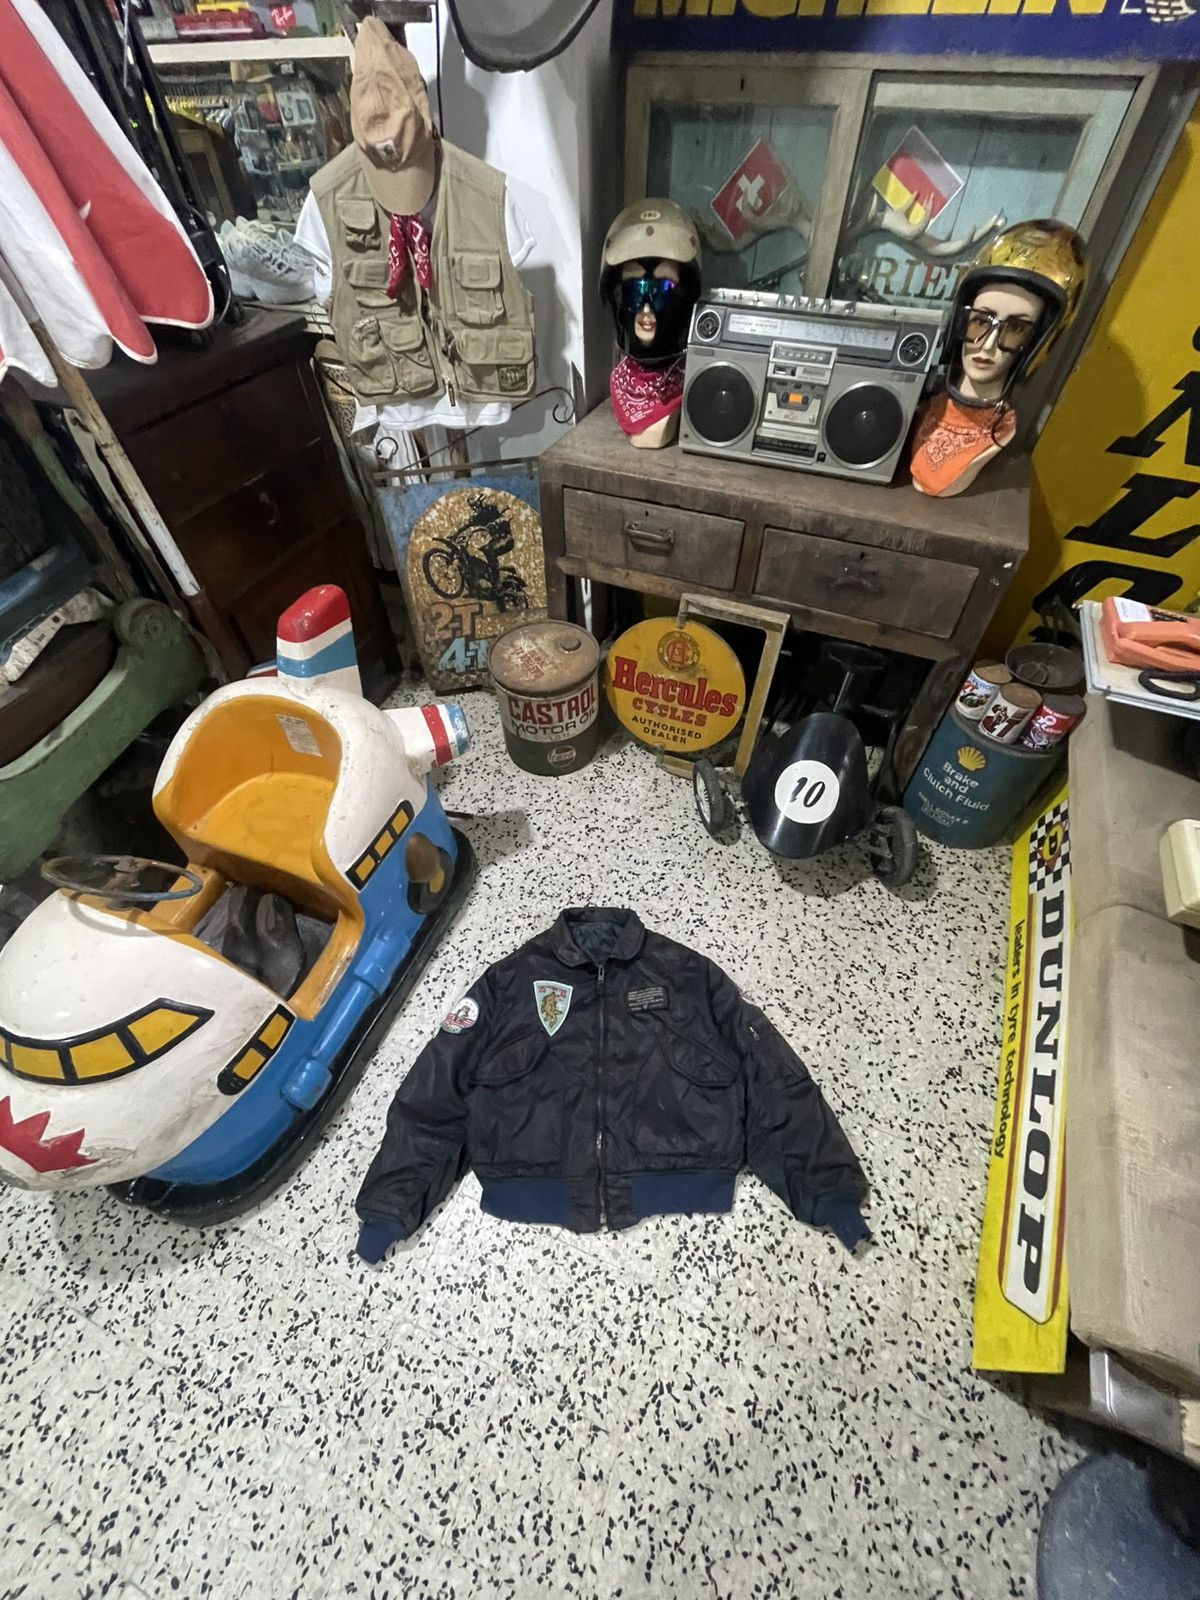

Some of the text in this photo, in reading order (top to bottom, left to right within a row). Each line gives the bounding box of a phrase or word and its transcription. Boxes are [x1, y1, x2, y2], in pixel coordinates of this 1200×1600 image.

[612, 655, 739, 717] Hercules
[507, 683, 596, 725] CASTROL
[632, 697, 708, 727] CYCLES
[511, 719, 577, 736] MOTOR
[631, 715, 702, 740] AUTHORISED
[643, 726, 687, 745] DEALER
[923, 767, 954, 800] Clutch
[955, 794, 991, 811] Fluid
[942, 761, 980, 788] Brake
[944, 776, 970, 794] and
[790, 776, 826, 808] 10
[994, 918, 1025, 1159] leaders in tyre technology
[1017, 890, 1064, 1295] DUNLOP
